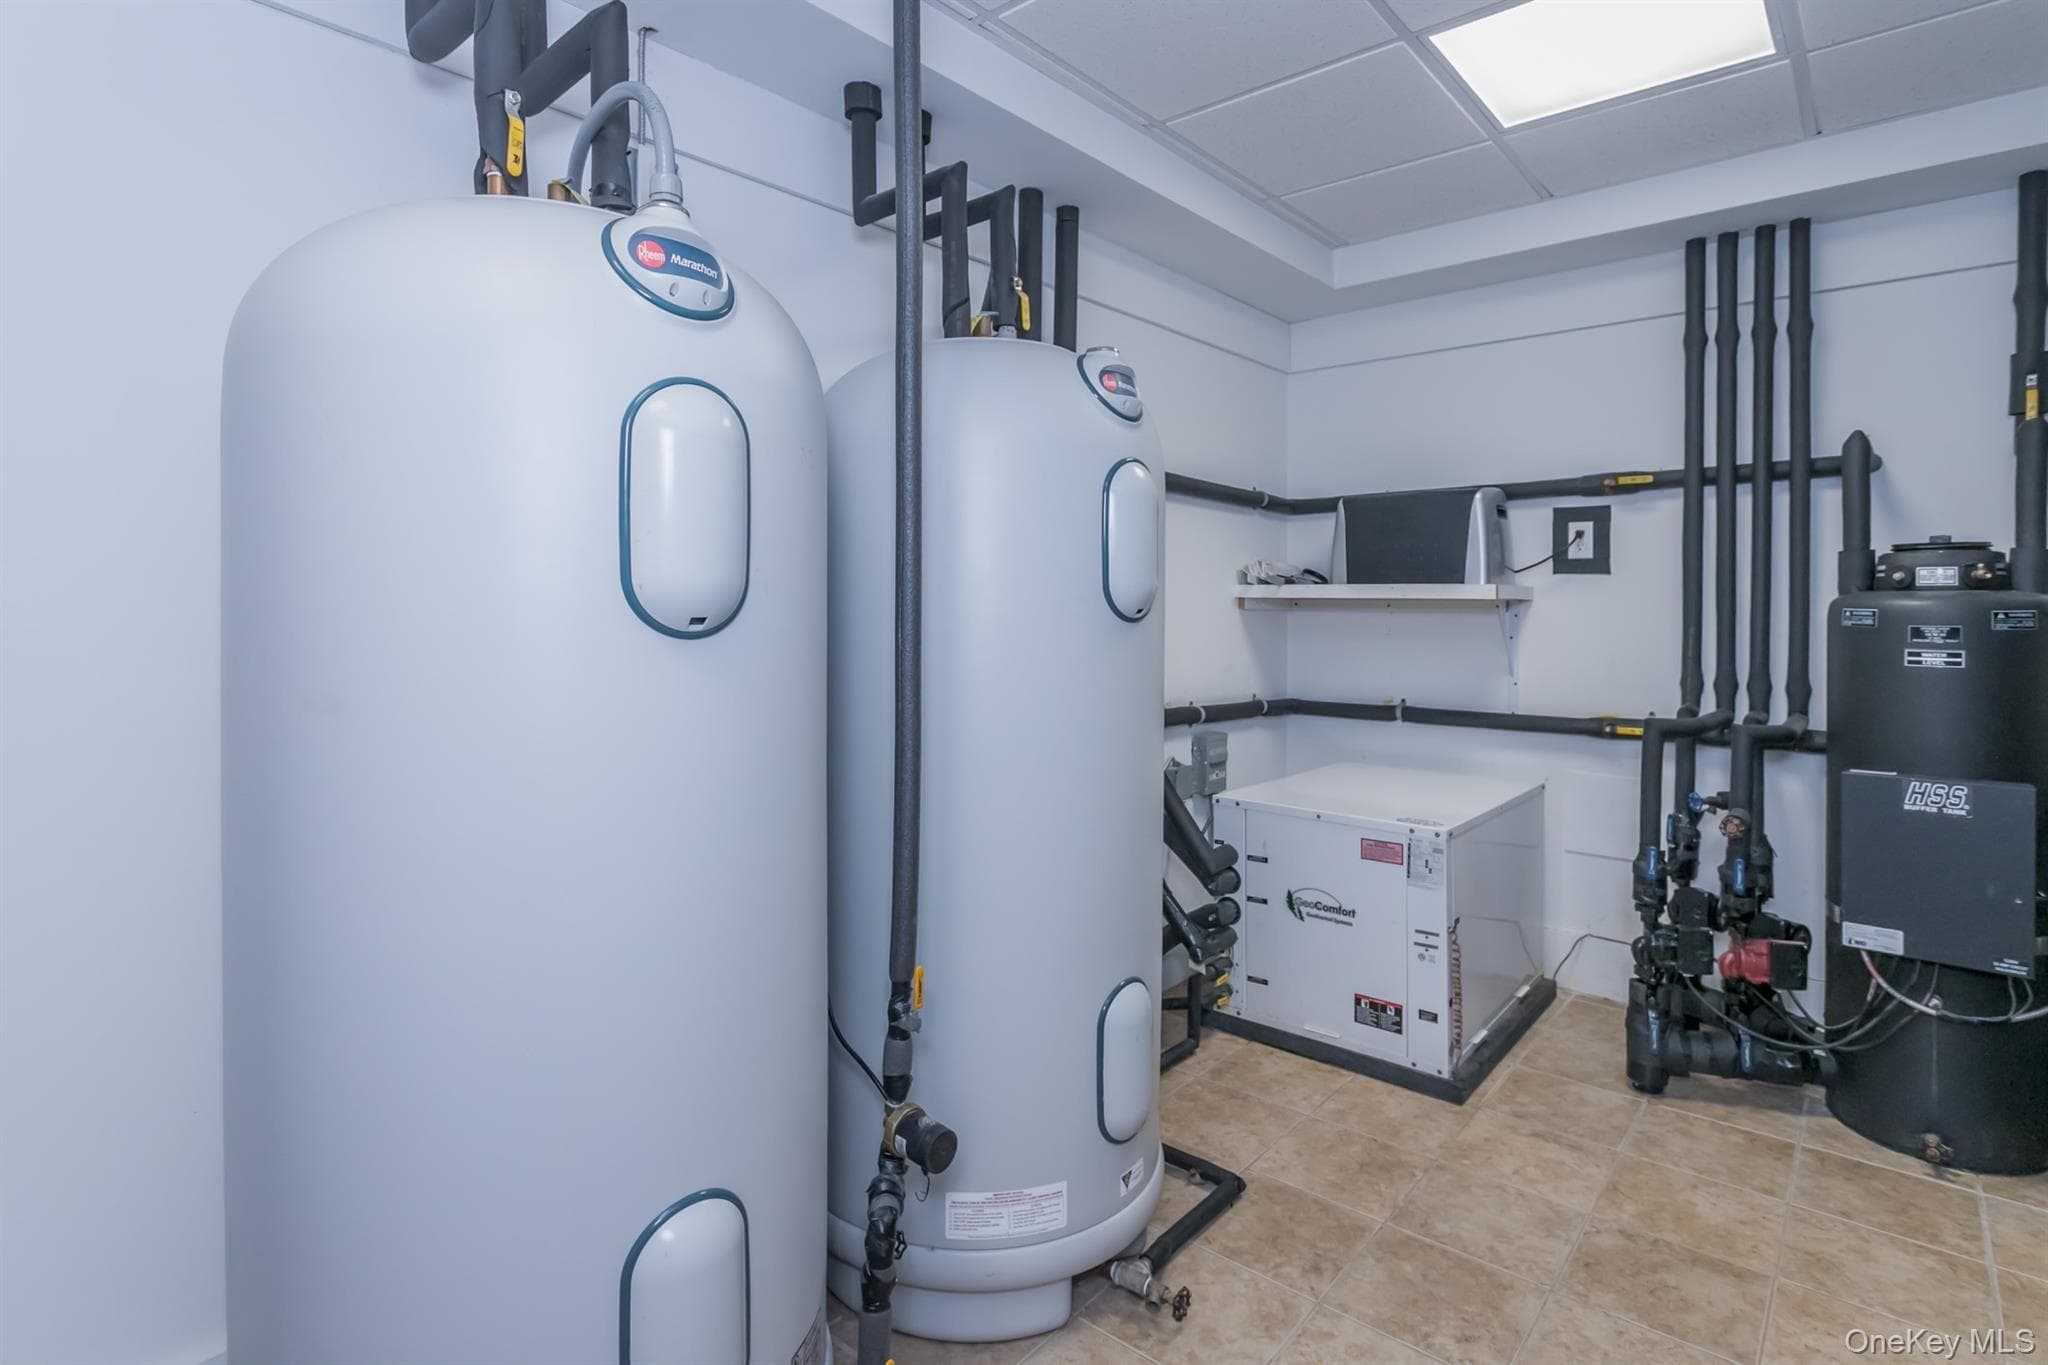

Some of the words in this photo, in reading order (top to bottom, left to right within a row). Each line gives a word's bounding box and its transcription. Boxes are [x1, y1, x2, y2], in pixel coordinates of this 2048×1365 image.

[670, 253, 719, 279] Marathon
[1903, 781, 1969, 809] HSS
[1903, 804, 1938, 813] BUFFER
[1942, 807, 1967, 816] TANK
[1295, 896, 1357, 919] GeoComfort
